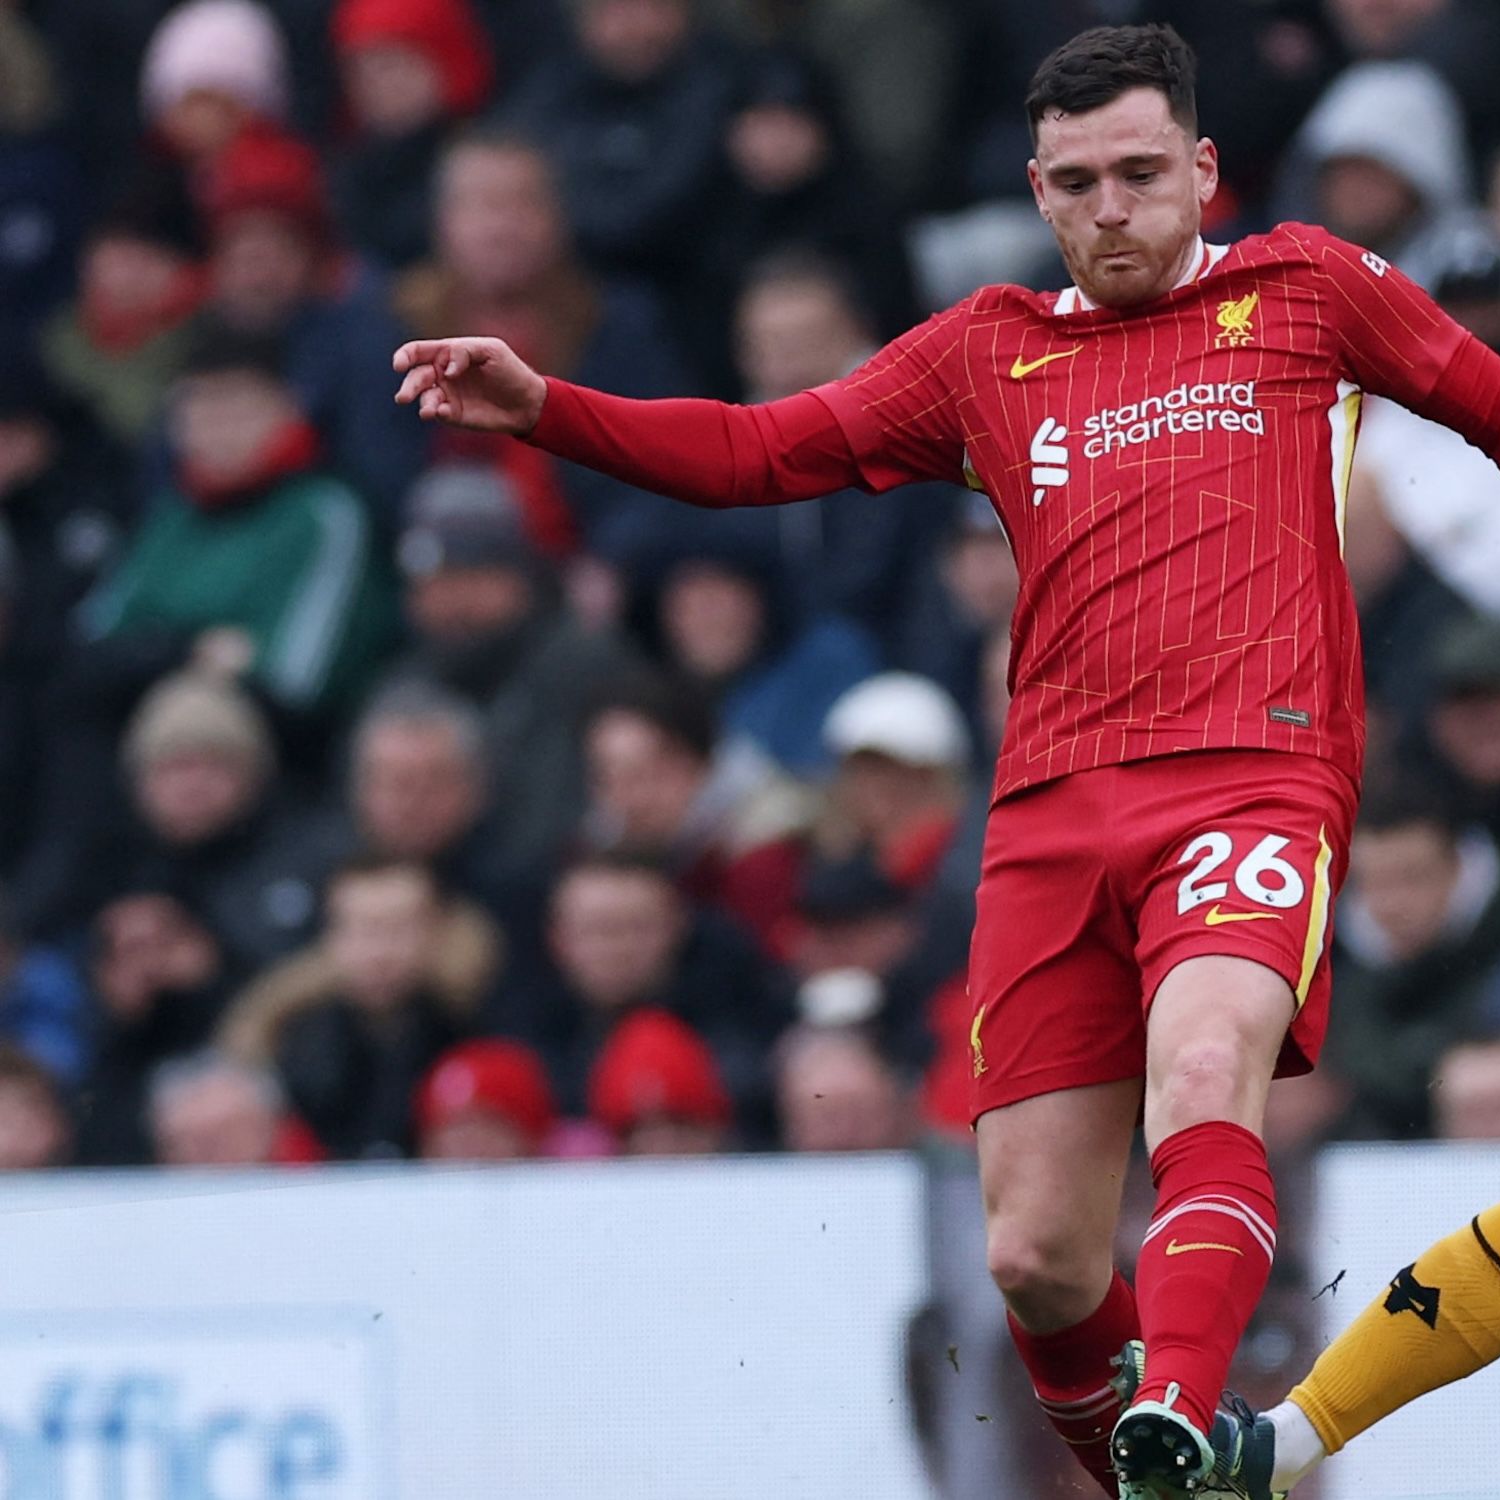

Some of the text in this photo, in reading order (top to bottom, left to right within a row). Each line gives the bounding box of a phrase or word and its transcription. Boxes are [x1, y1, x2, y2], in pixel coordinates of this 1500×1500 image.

[1214, 335, 1255, 349] LFC
[1083, 408, 1265, 459] chartered
[1084, 381, 1255, 436] standard
[1177, 831, 1305, 916] 26
